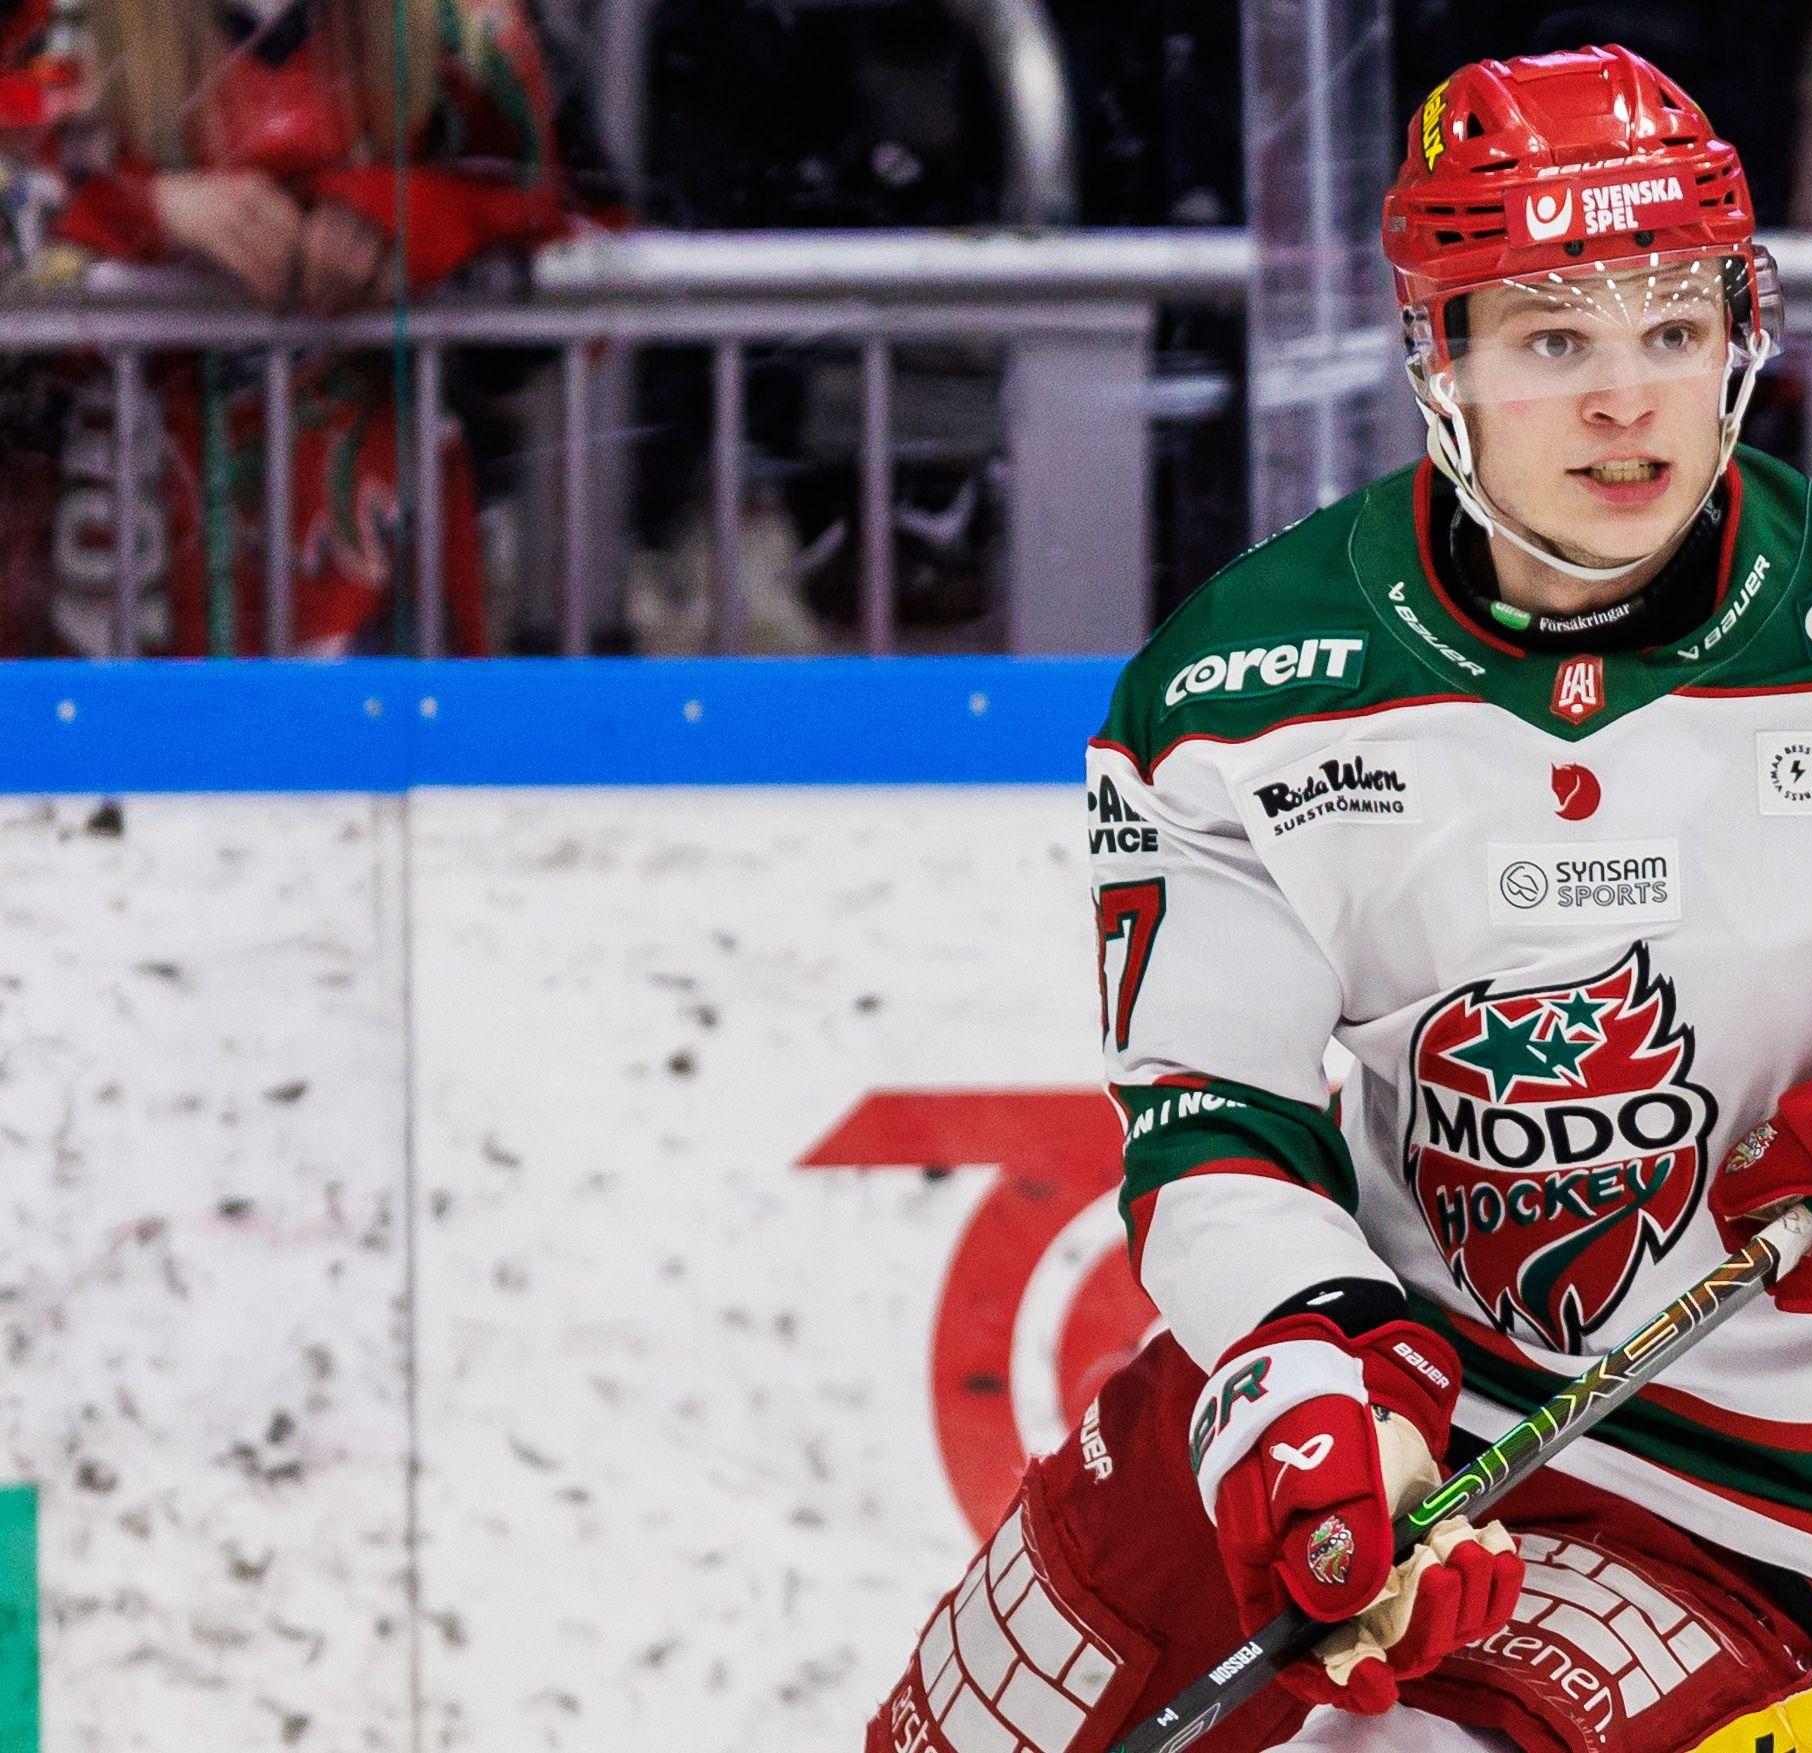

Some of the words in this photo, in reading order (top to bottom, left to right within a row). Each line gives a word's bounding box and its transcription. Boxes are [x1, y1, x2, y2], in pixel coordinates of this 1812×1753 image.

[1581, 177, 1683, 212] SVENSKA
[1584, 206, 1639, 235] SPEL
[1273, 795, 1404, 836] SURSTRÖMMING
[1556, 856, 1668, 883] SYNSAM
[1557, 880, 1669, 909] SPORTS
[1091, 876, 1166, 1053] 7
[1421, 1092, 1694, 1170] MODO
[1436, 1152, 1676, 1254] HOCKEY
[1208, 1640, 1264, 1686] PERSSON
